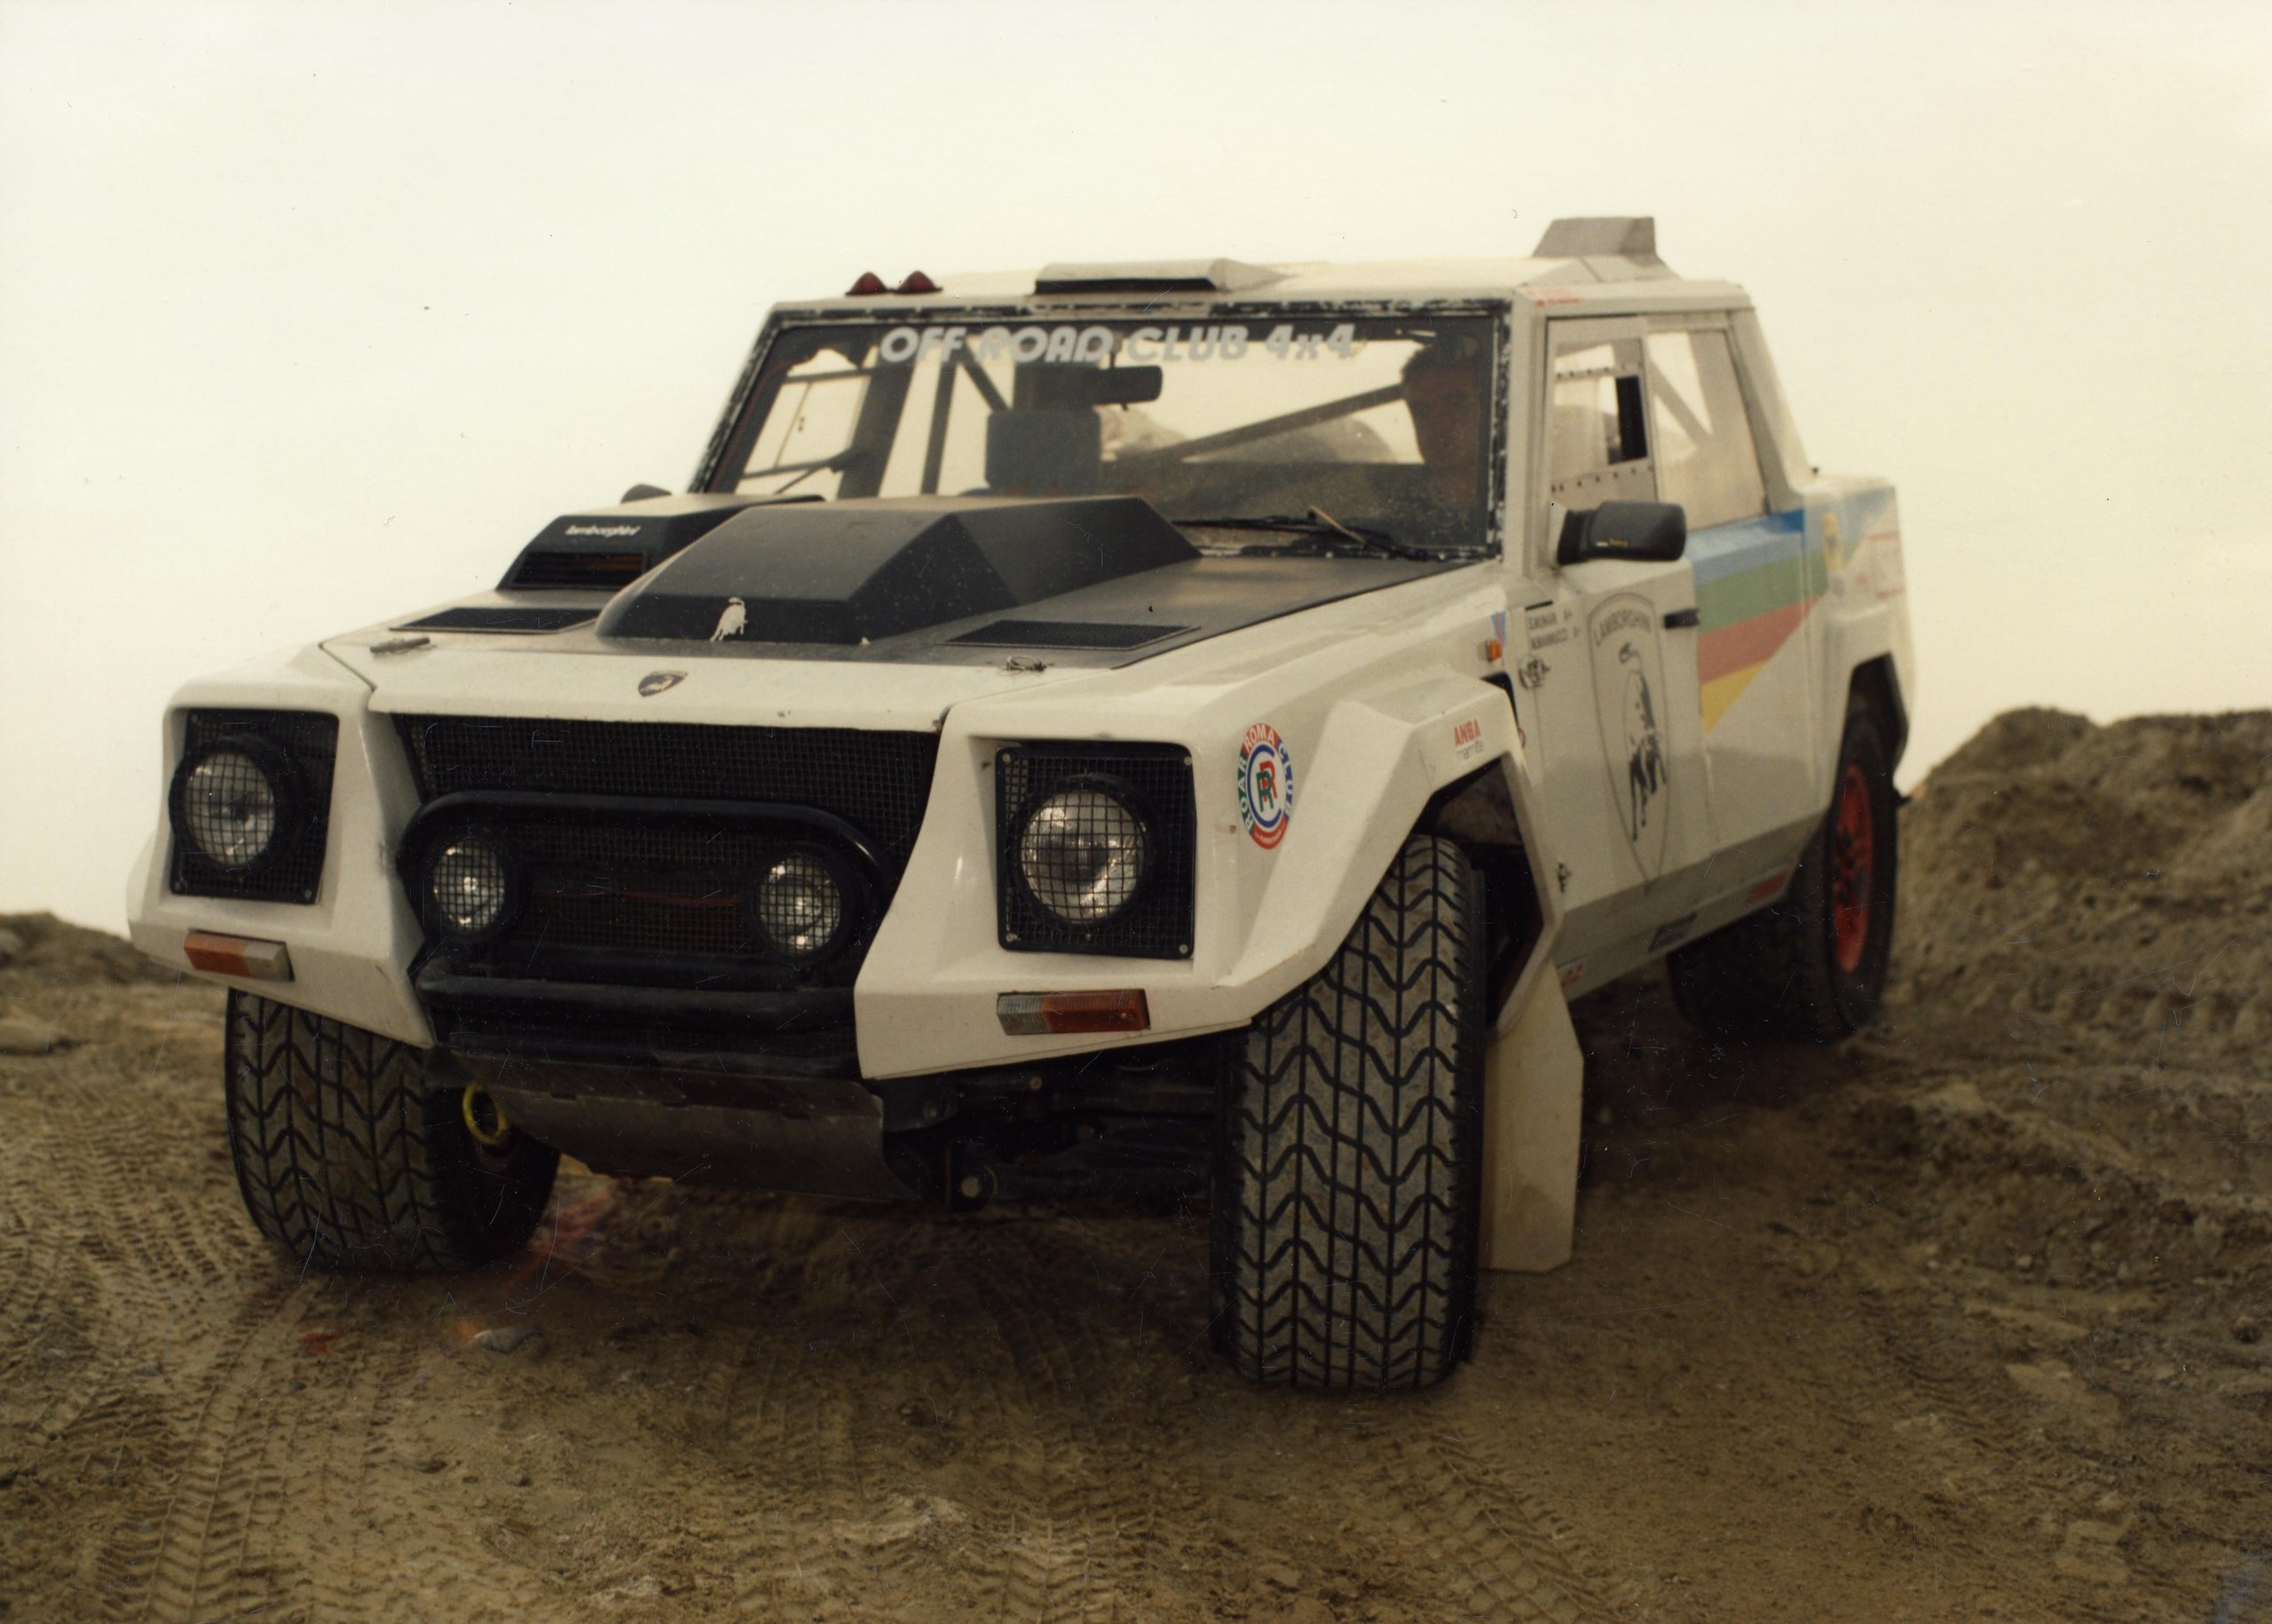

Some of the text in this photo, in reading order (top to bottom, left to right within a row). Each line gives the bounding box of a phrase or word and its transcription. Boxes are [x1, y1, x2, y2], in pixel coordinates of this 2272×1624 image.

[880, 323, 1356, 364] OFF ROAD CLUB 4x4
[1243, 722, 1275, 753] ROMA
[1237, 742, 1293, 832] ROAR CLUB
